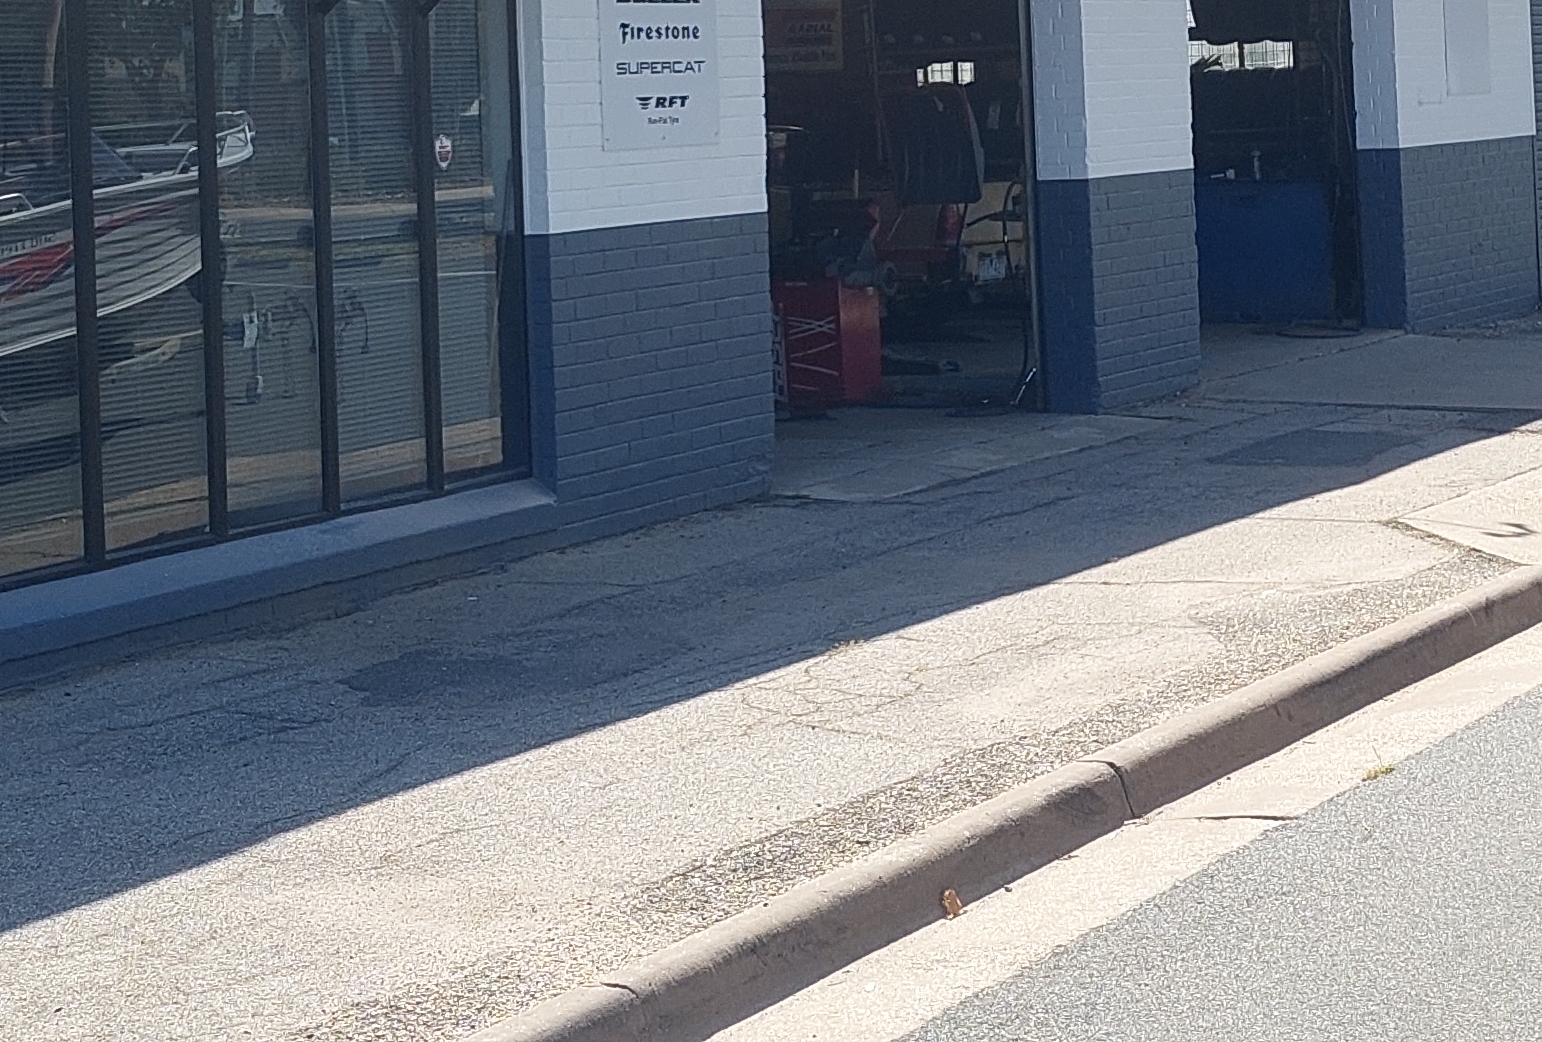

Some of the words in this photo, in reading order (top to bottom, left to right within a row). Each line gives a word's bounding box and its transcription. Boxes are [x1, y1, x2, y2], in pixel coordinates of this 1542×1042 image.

[619, 22, 701, 45] Firestone
[616, 60, 706, 76] SUPERCAT
[654, 94, 690, 109] RFT
